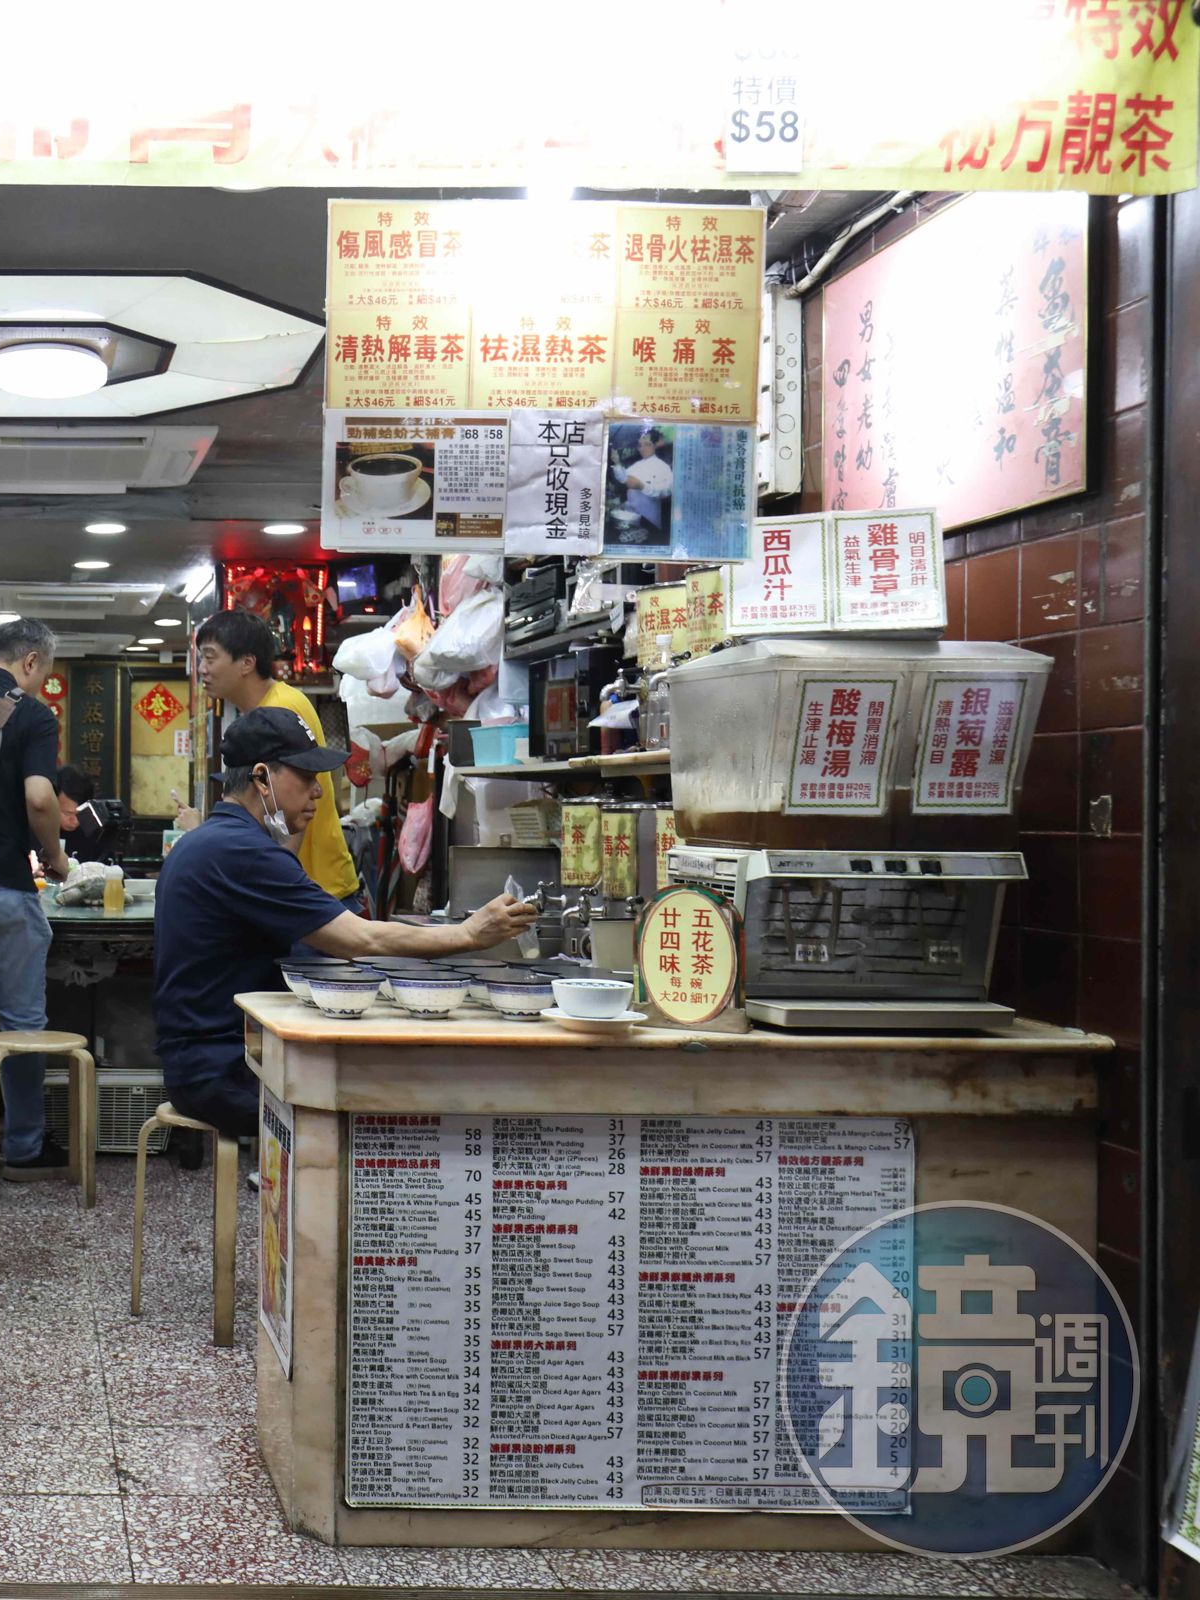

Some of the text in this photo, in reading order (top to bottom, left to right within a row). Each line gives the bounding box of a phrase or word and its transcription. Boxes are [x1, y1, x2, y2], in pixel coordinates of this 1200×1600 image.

[732, 75, 797, 105] 特價
[730, 108, 799, 143] $58
[377, 211, 430, 228] 特效
[666, 215, 718, 231] 特效
[376, 315, 429, 330] 特效
[659, 318, 711, 334] 特效
[335, 334, 464, 363] 清熱解毒茶
[632, 336, 736, 365] 喉痛茶
[538, 421, 585, 445] 本店
[545, 444, 569, 541] 只收現金
[762, 528, 792, 602] 西瓜汁
[867, 522, 900, 597] 雞骨草
[820, 688, 862, 778] 酸梅湯
[948, 688, 992, 778] 銀菊露
[659, 908, 681, 975] 廿四味
[692, 908, 714, 976] 五花茶
[608, 1120, 624, 1131] 31
[465, 1129, 482, 1140] 58
[608, 1134, 625, 1146] 37
[465, 1144, 482, 1156] 58
[608, 1148, 625, 1160] 26
[465, 1170, 482, 1182] 70
[608, 1163, 625, 1175] 28
[465, 1193, 482, 1205] 45
[608, 1208, 625, 1220] 42
[608, 1236, 625, 1247] 43
[464, 1318, 481, 1330] 35
[754, 1381, 770, 1393] 57
[463, 1486, 479, 1498] 32
